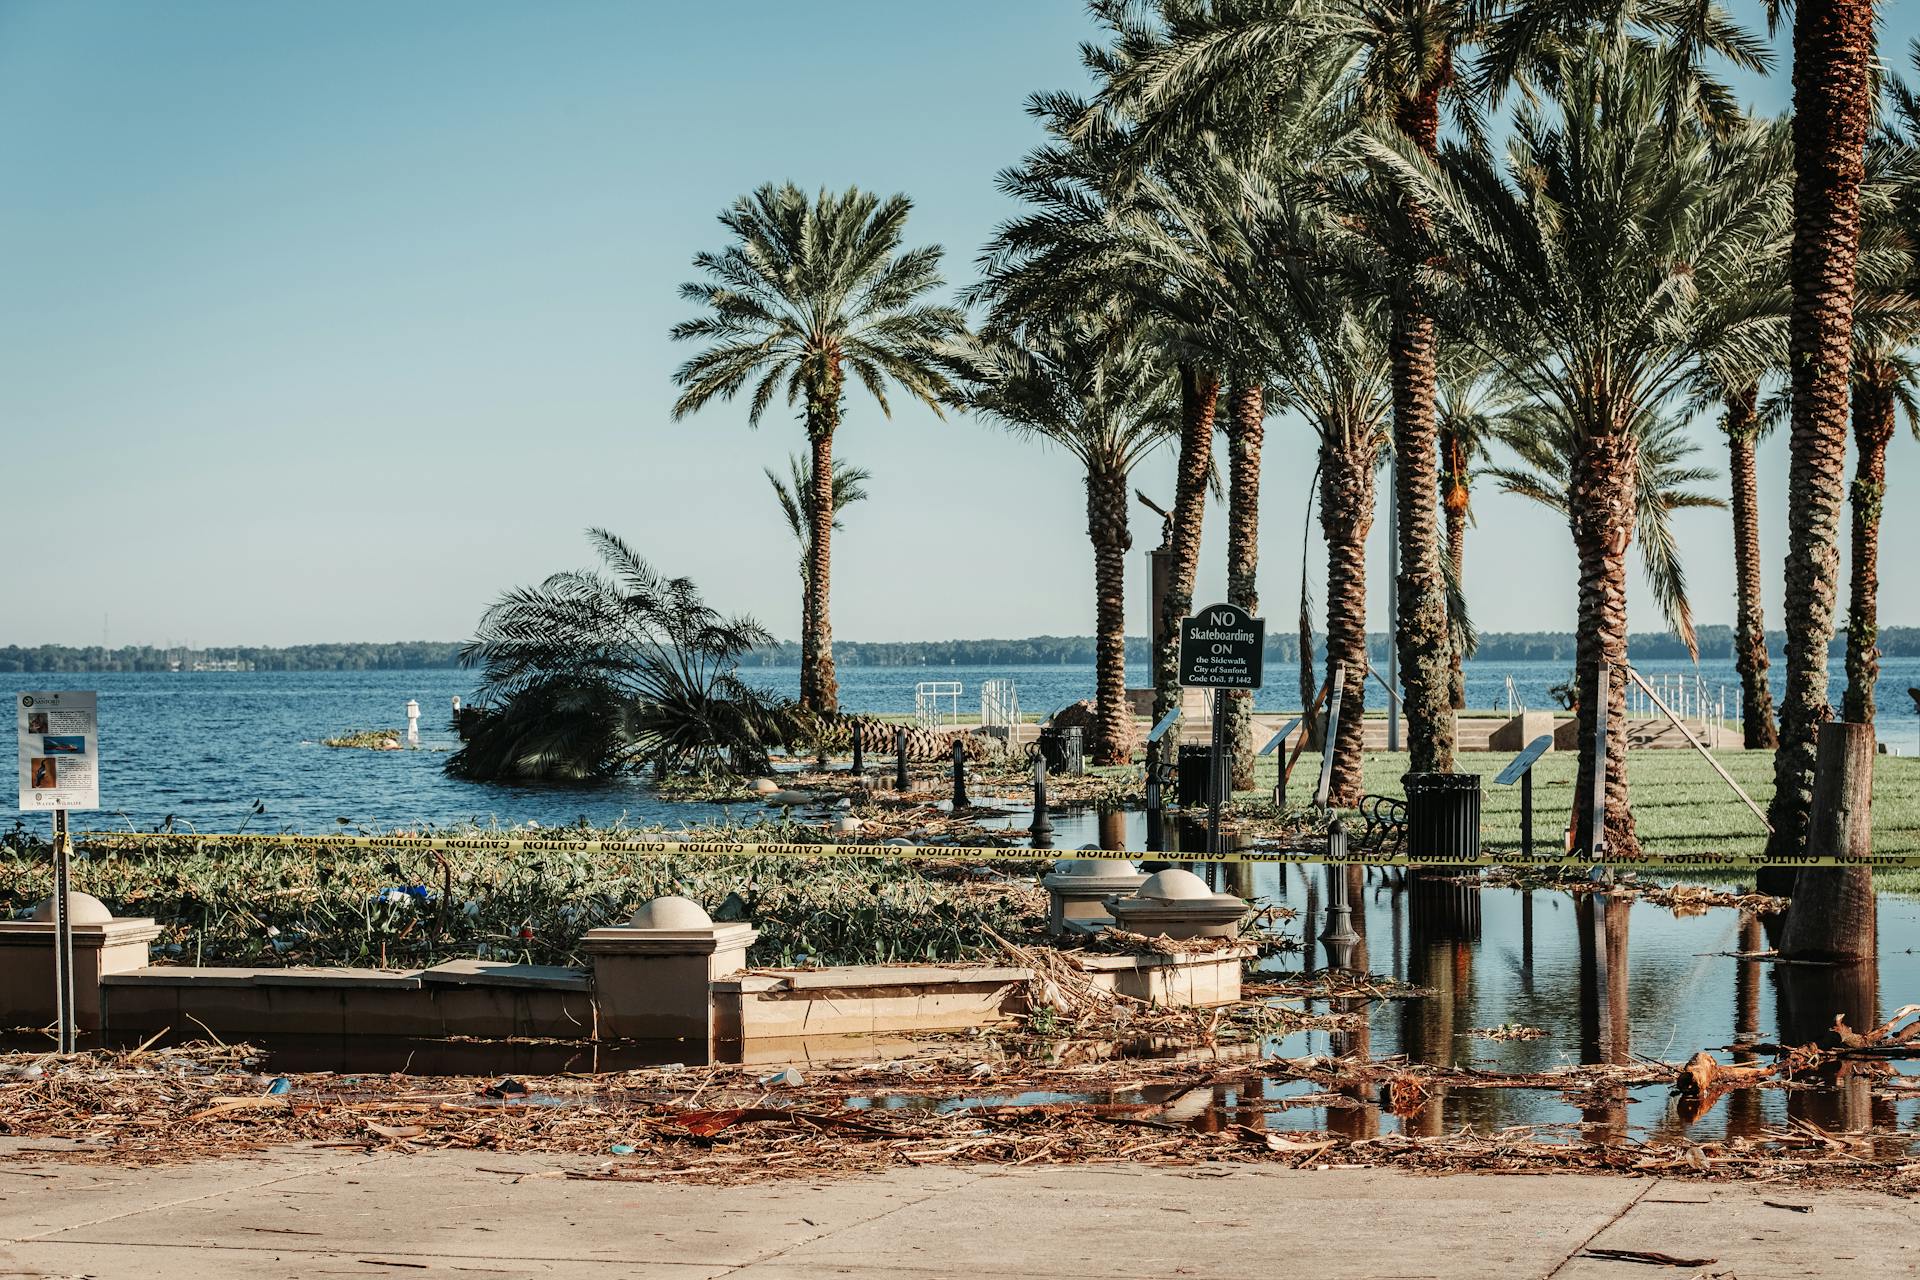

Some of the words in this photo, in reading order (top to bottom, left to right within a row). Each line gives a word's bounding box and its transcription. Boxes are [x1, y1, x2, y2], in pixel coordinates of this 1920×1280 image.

[1210, 611, 1236, 626] NO
[1190, 627, 1254, 644] Skateboarding
[1211, 643, 1233, 654] ON
[1196, 656, 1209, 664] the
[1210, 656, 1246, 665] Sidewalk
[1193, 665, 1209, 674] City
[1210, 665, 1218, 673] of
[1219, 666, 1248, 674] Sanford
[1189, 674, 1208, 682] Code
[1209, 675, 1226, 683] Ord.
[369, 839, 432, 848] CAUTION
[446, 840, 510, 849] CAUTION
[523, 841, 587, 850] CAUTION
[600, 842, 665, 852] CAUTION
[678, 843, 744, 853] CAUTION
[757, 844, 823, 854] CAUTION
[836, 845, 902, 855] CAUTION
[916, 847, 982, 856] CAUTION
[995, 848, 1062, 858] CAUTION
[1076, 850, 1144, 859] CAUTION
[1158, 852, 1225, 860] CAUTION
